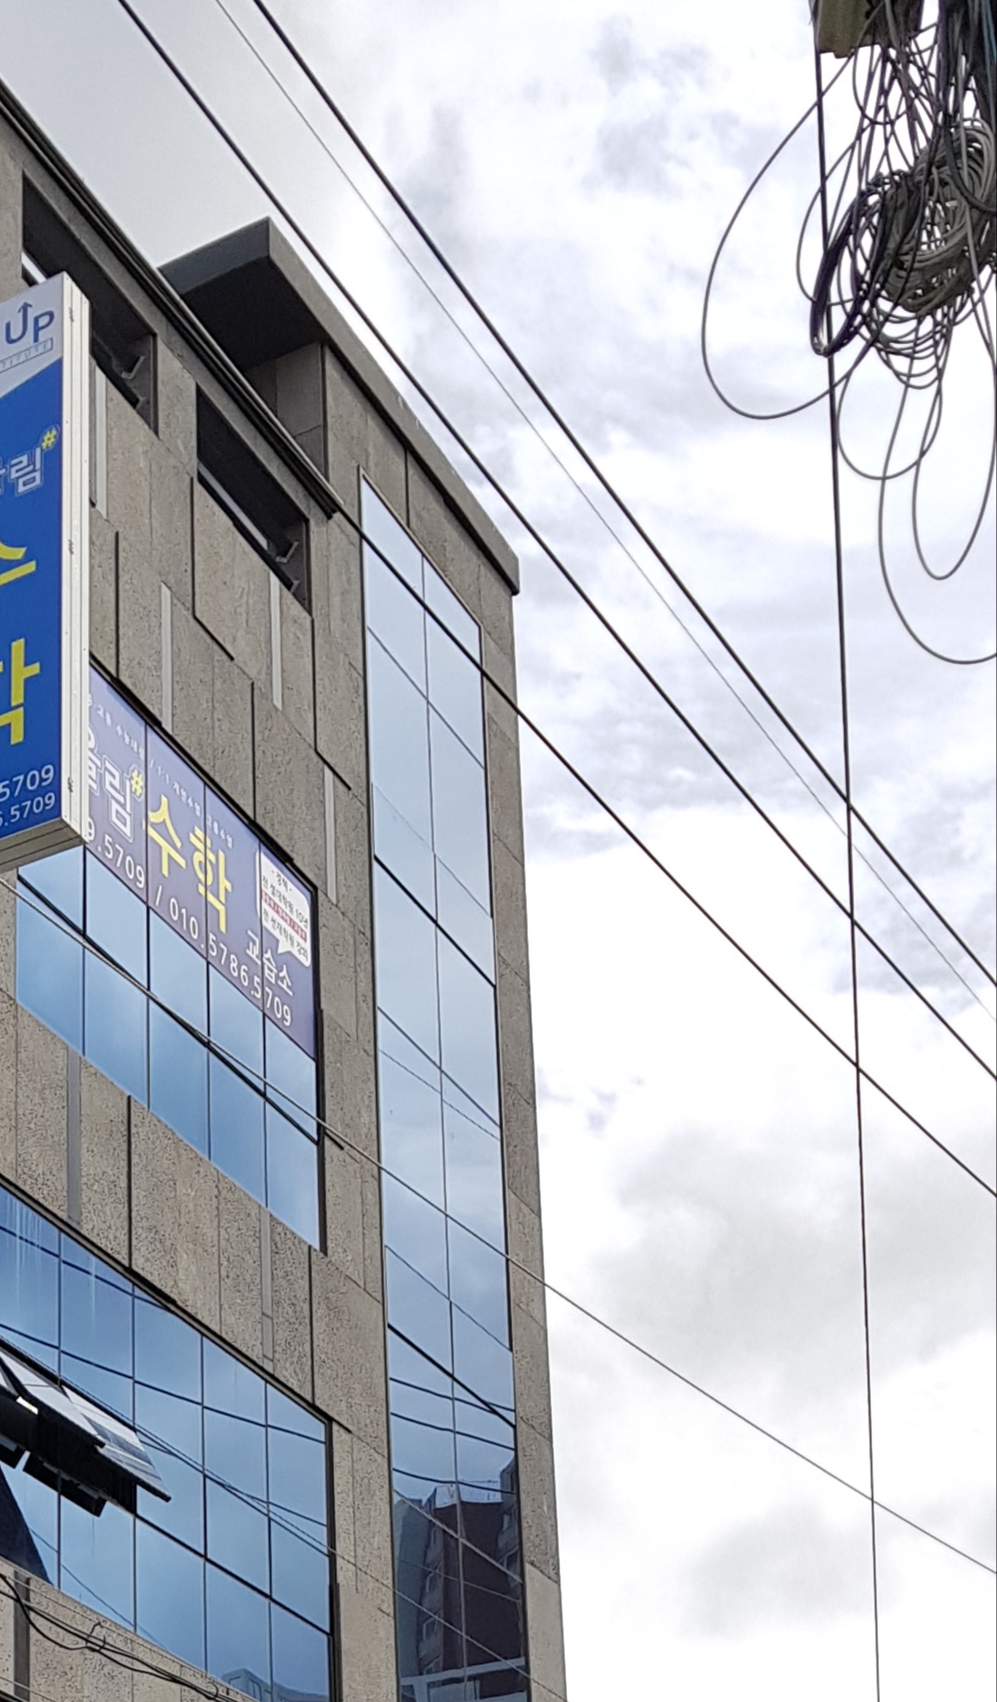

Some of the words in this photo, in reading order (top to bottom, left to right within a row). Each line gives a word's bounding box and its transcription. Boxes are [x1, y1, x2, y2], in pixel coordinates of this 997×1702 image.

[5, 302, 55, 344] UP
[169, 898, 292, 1027] 010.5786.5709
[246, 930, 294, 997] 교습소
